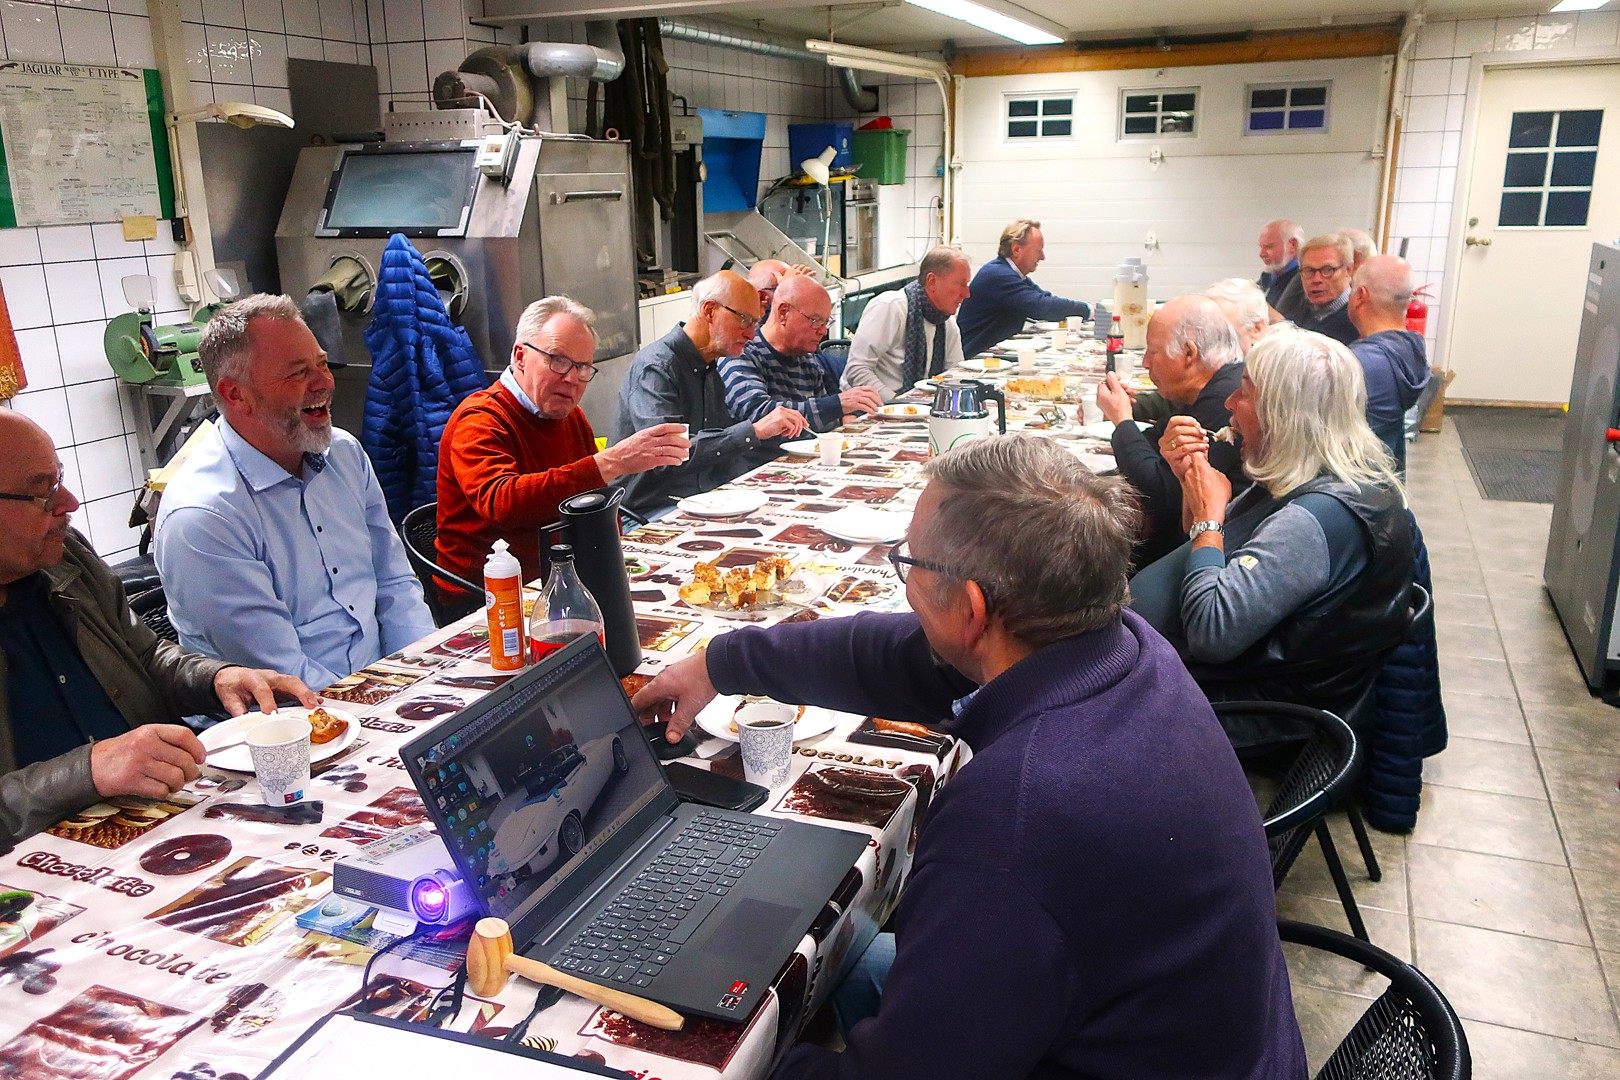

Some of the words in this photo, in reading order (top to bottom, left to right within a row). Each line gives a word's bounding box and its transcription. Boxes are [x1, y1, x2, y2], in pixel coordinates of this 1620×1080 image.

[20, 63, 62, 75] JAGUAR
[97, 69, 119, 78] TYPE
[16, 851, 155, 897] Chocolte
[71, 930, 232, 984] chocolate
